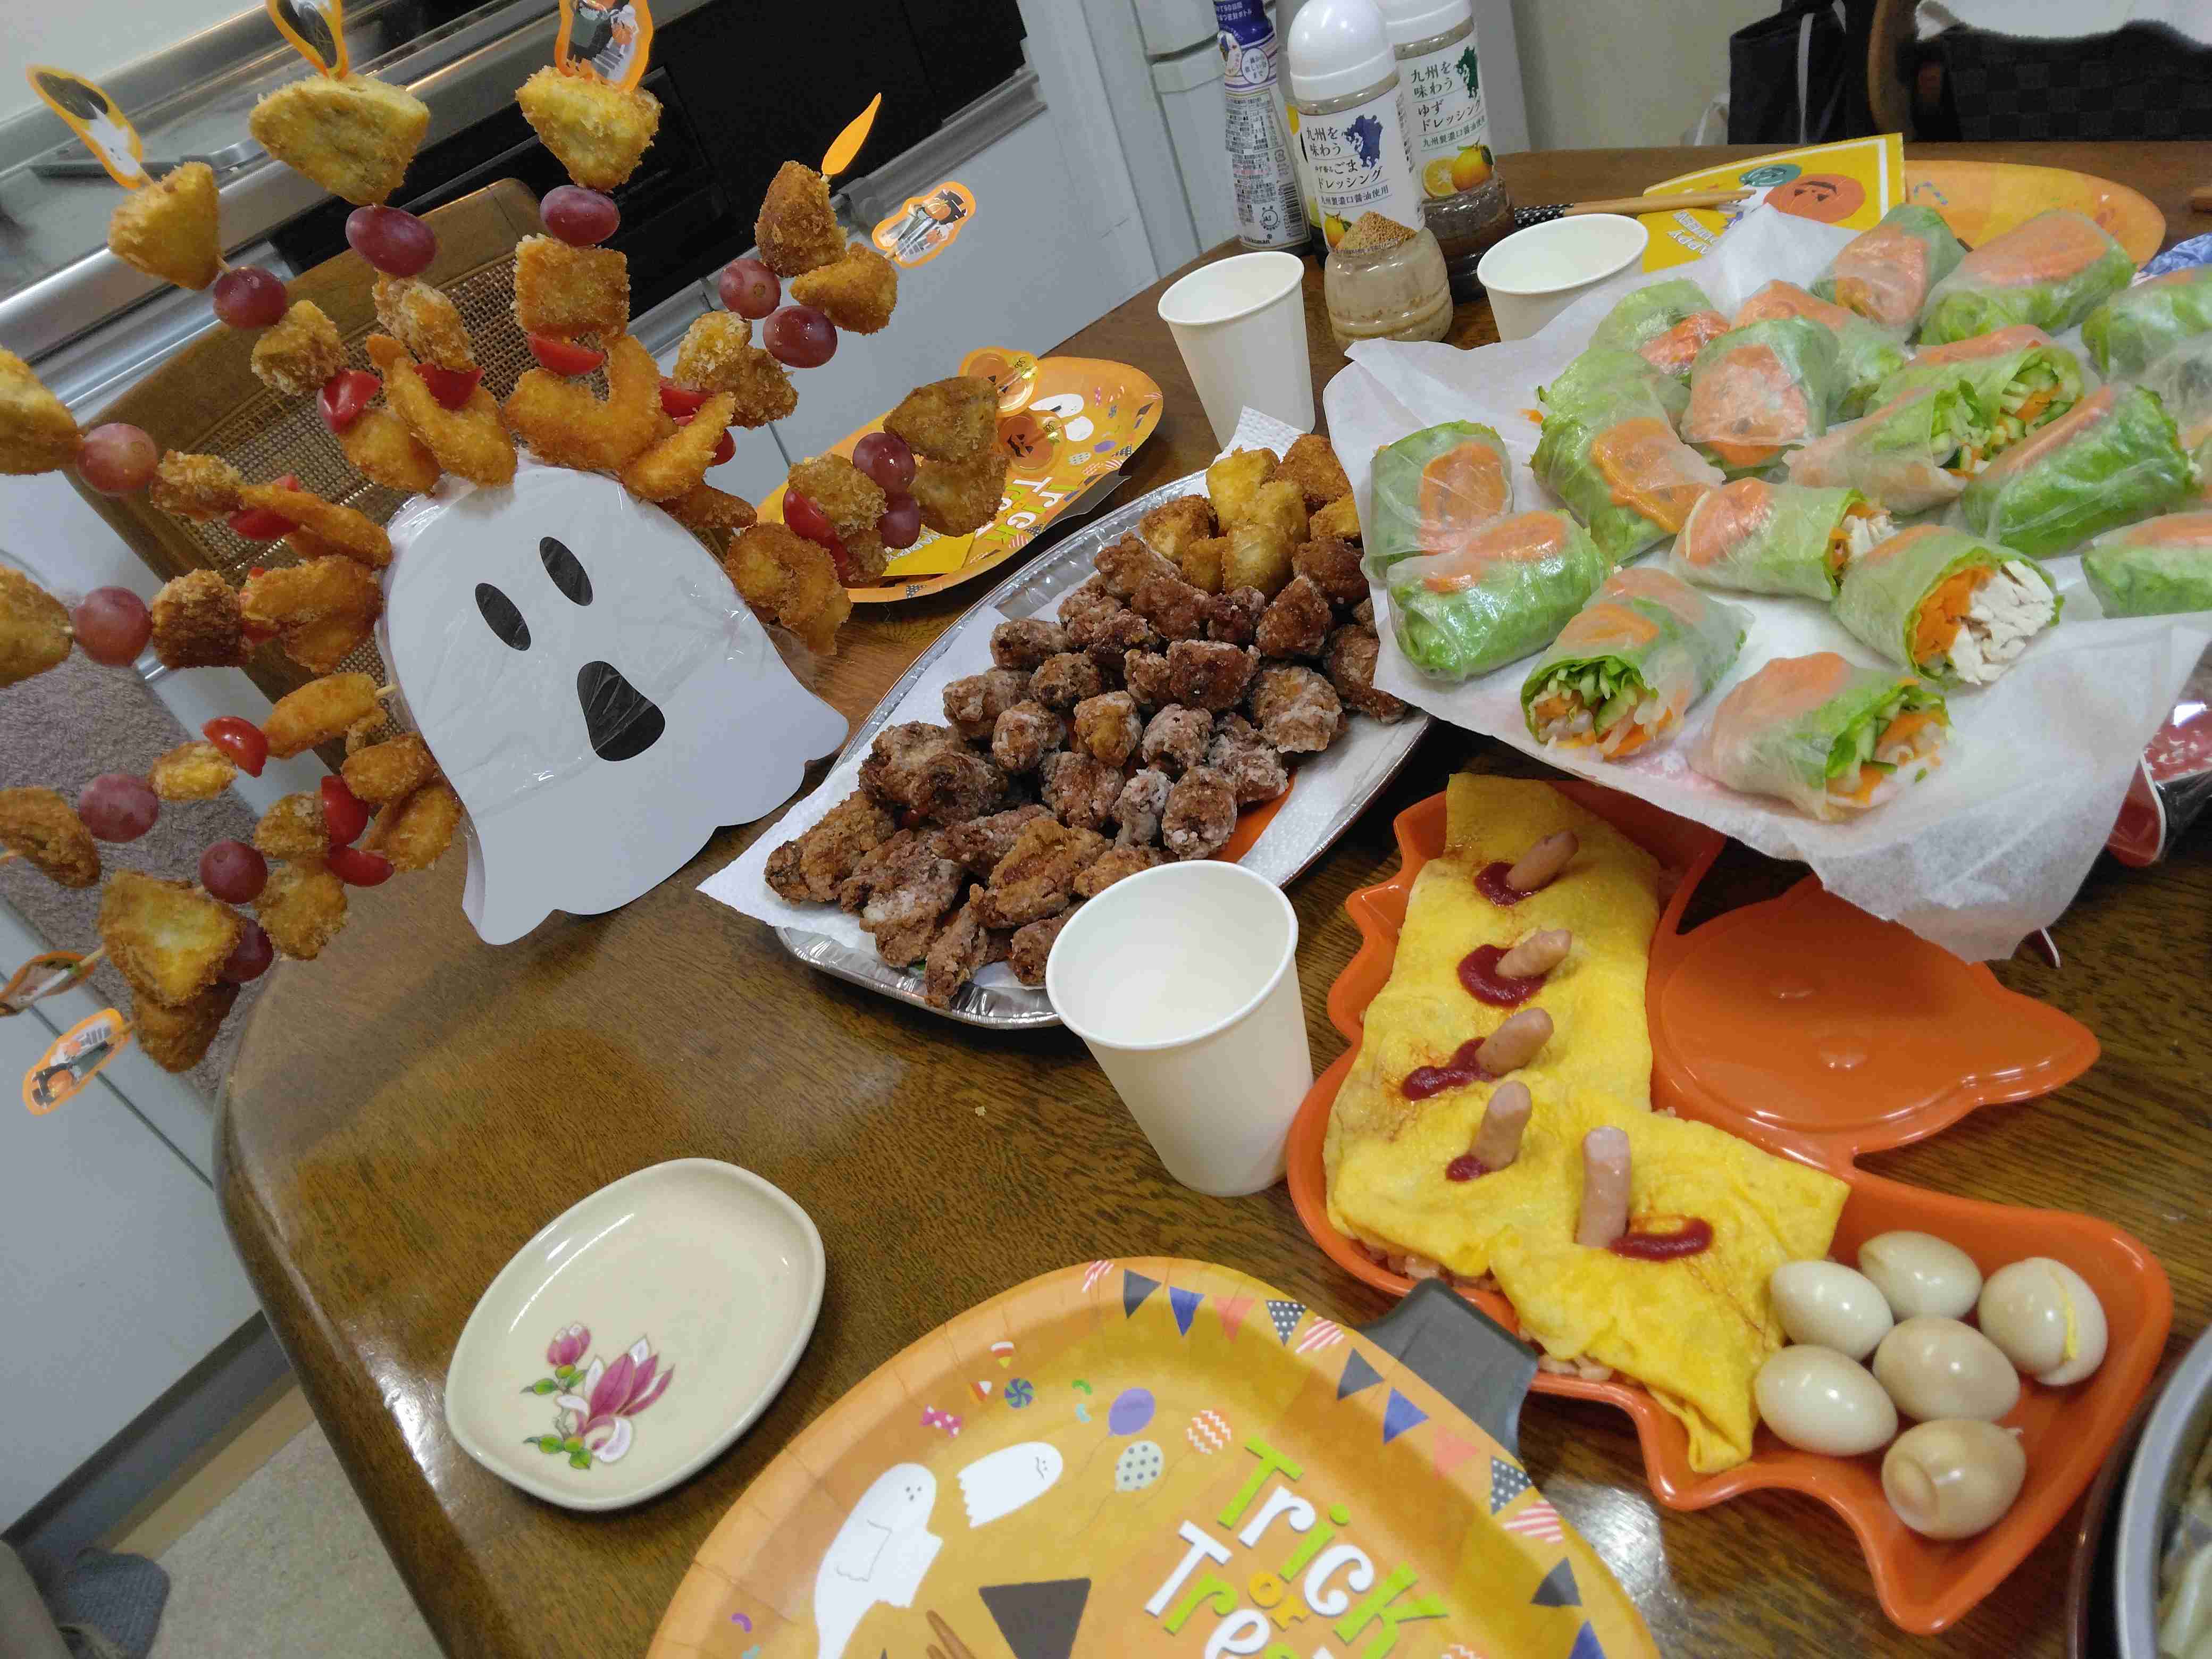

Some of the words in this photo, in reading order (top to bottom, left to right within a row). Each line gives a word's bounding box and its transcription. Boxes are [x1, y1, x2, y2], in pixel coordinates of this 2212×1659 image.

[1411, 61, 1451, 83] 九州を
[1414, 77, 1453, 98] 味わう
[1418, 99, 1444, 116] ゆず
[1306, 126, 1338, 141] 九州を
[1310, 143, 1341, 157] 味わう
[1318, 165, 1383, 189] ドレッシング
[1218, 1435, 1449, 1659] Trick
[1144, 1519, 1335, 1659] Tre
[1249, 1571, 1310, 1632] or
